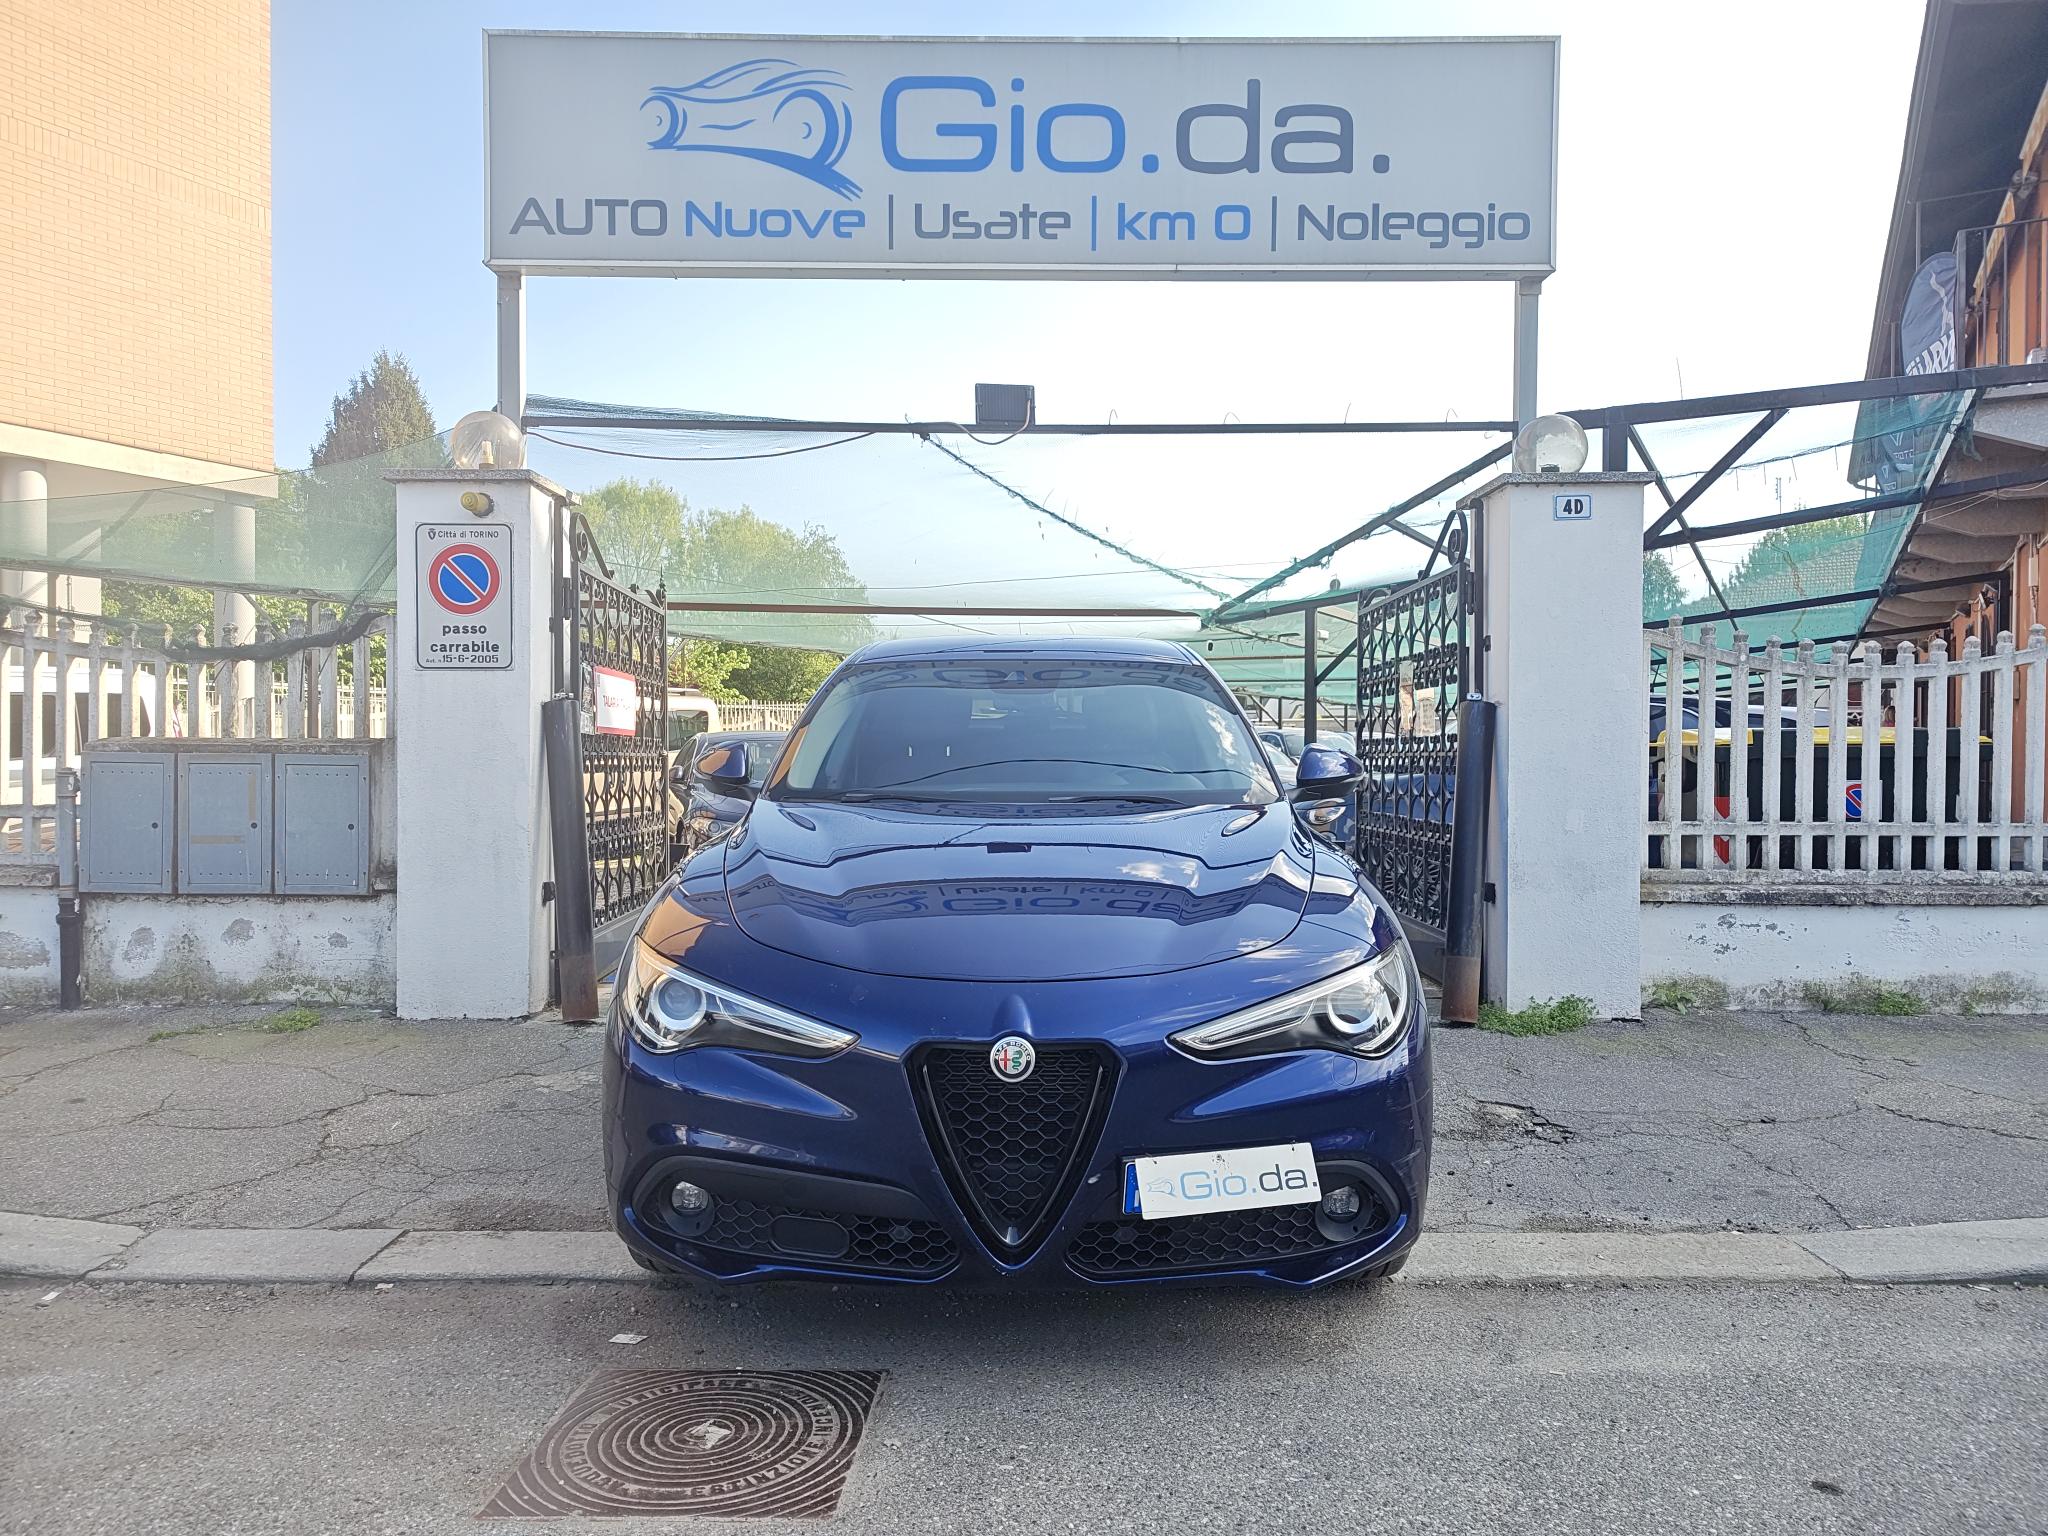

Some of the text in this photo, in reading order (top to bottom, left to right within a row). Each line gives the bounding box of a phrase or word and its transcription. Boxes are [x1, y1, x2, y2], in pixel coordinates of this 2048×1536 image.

[880, 75, 1390, 174] Gio.da.
[509, 197, 1531, 249] AUTO Nuove Usate km 0 Noleggio
[1563, 498, 1584, 515] 4D
[438, 530, 499, 539] Città di TORINO
[442, 624, 487, 636] passo
[430, 640, 500, 653] carrabile
[993, 1041, 1031, 1061] ALFA ROMEO
[1179, 1163, 1318, 1201] Gio.da.
